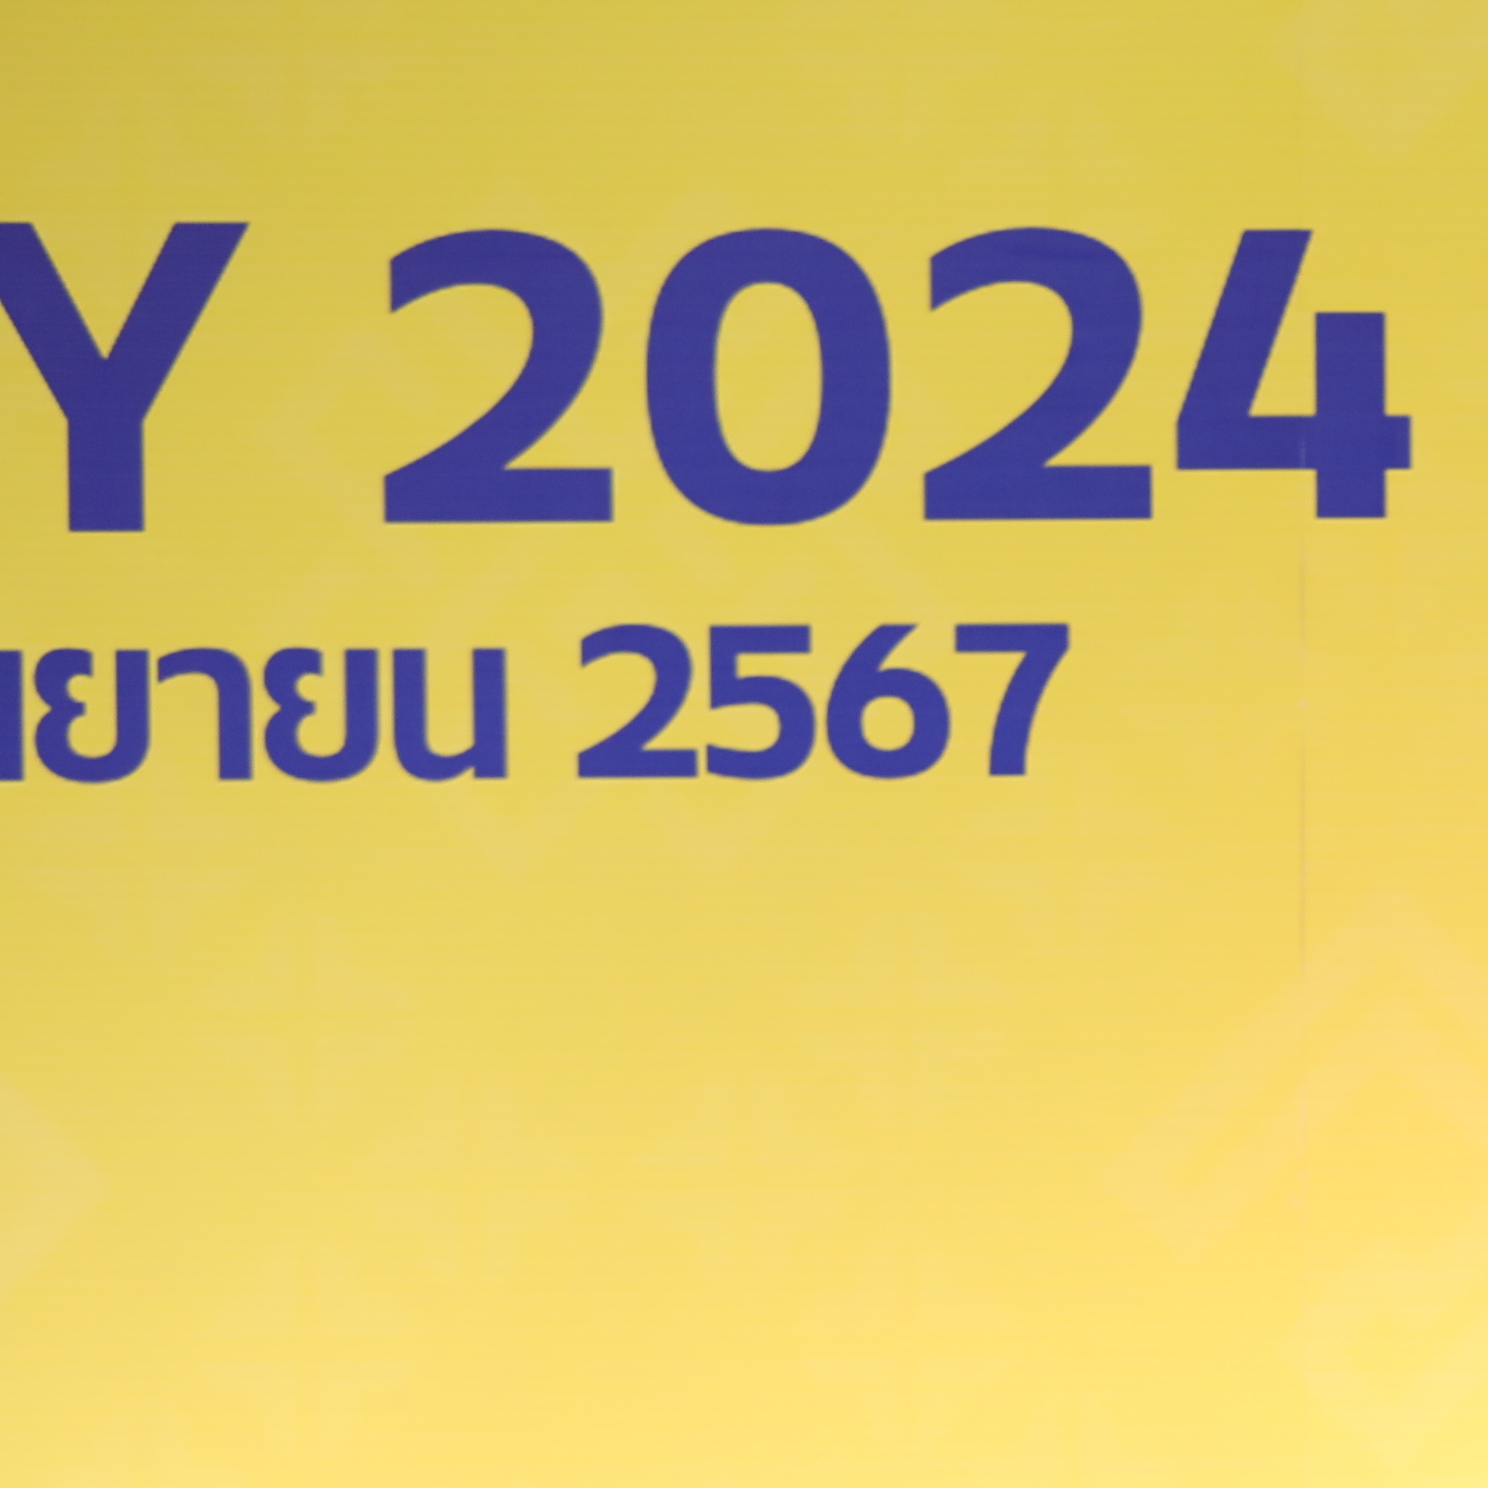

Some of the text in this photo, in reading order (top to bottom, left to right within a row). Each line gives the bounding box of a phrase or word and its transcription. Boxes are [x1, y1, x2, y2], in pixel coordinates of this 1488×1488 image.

[0, 222, 1411, 531] Y 2024
[0, 624, 1068, 782] ยายน 2567
